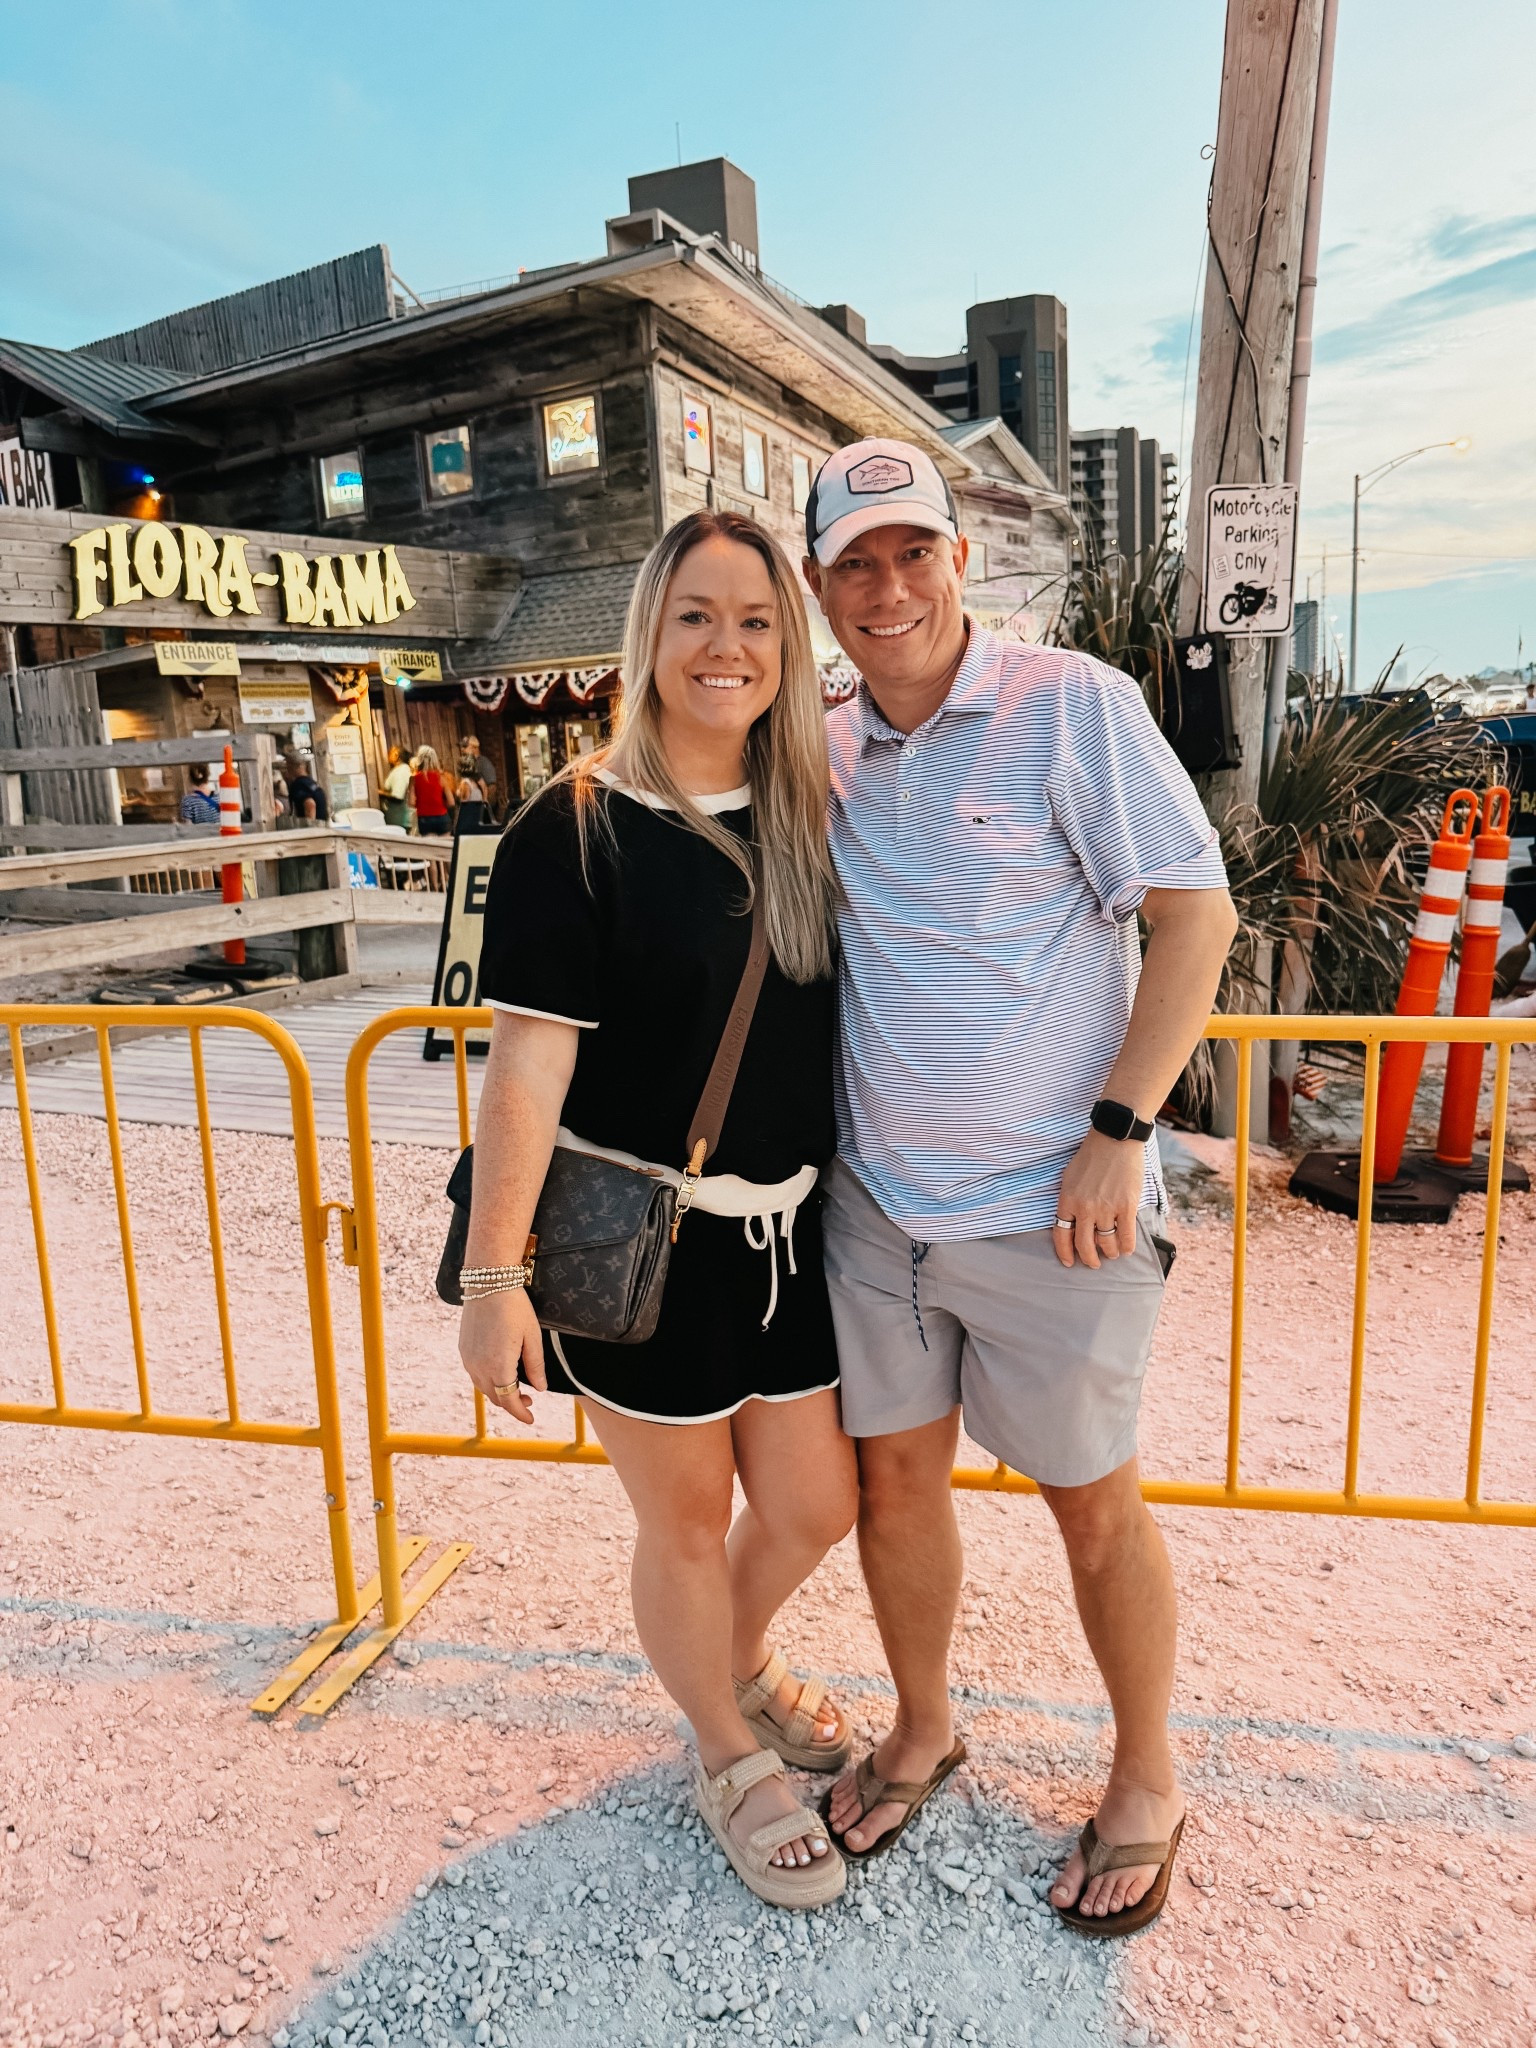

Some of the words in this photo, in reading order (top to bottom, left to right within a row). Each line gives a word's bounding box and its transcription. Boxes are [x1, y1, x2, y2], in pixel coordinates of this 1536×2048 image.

[10, 448, 51, 509] BAR
[1225, 525, 1279, 548] Parking
[68, 521, 417, 627] FLORA-BAMA
[1235, 552, 1267, 574] Only
[161, 644, 235, 661] ENTRANCE
[383, 652, 438, 668] ENTRANCE
